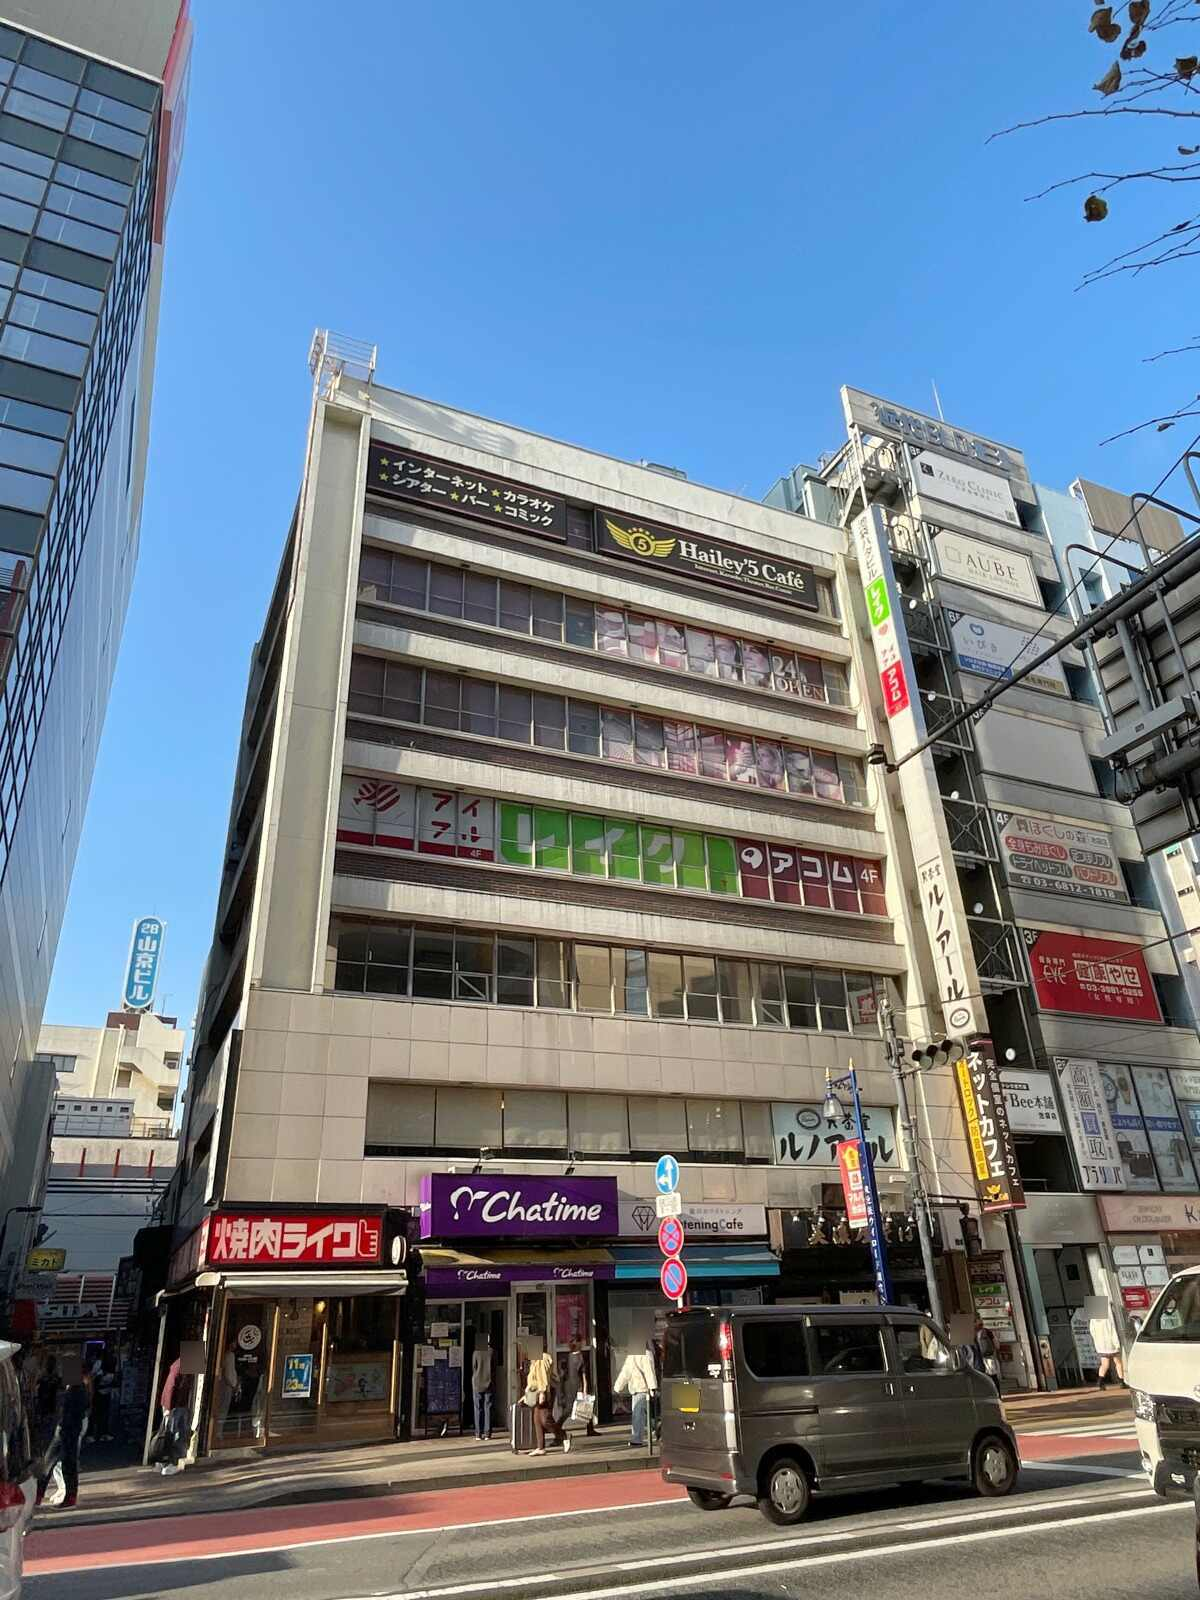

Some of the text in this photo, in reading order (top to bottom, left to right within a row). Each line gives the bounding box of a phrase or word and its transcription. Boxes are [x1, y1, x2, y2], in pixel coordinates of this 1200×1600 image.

[392, 474, 553, 527] シアター バー コミック
[393, 460, 555, 512] インターネット カラオケ
[762, 564, 805, 590] Café
[966, 554, 1015, 581] AUBE
[776, 679, 823, 701] OPEN
[996, 813, 1009, 825] 4F
[469, 848, 482, 859] 4F
[516, 813, 685, 874] レイク
[772, 851, 879, 884] アコム 4F
[928, 884, 965, 1001] ルノアール
[1024, 930, 1038, 945] 3F
[966, 1051, 1006, 1178] ネットカフェ
[780, 1132, 894, 1163] ルノアル
[482, 1191, 602, 1223] Chatime
[212, 1218, 358, 1259] 焼肉ライク
[466, 1268, 594, 1280] Chatime Chatime
